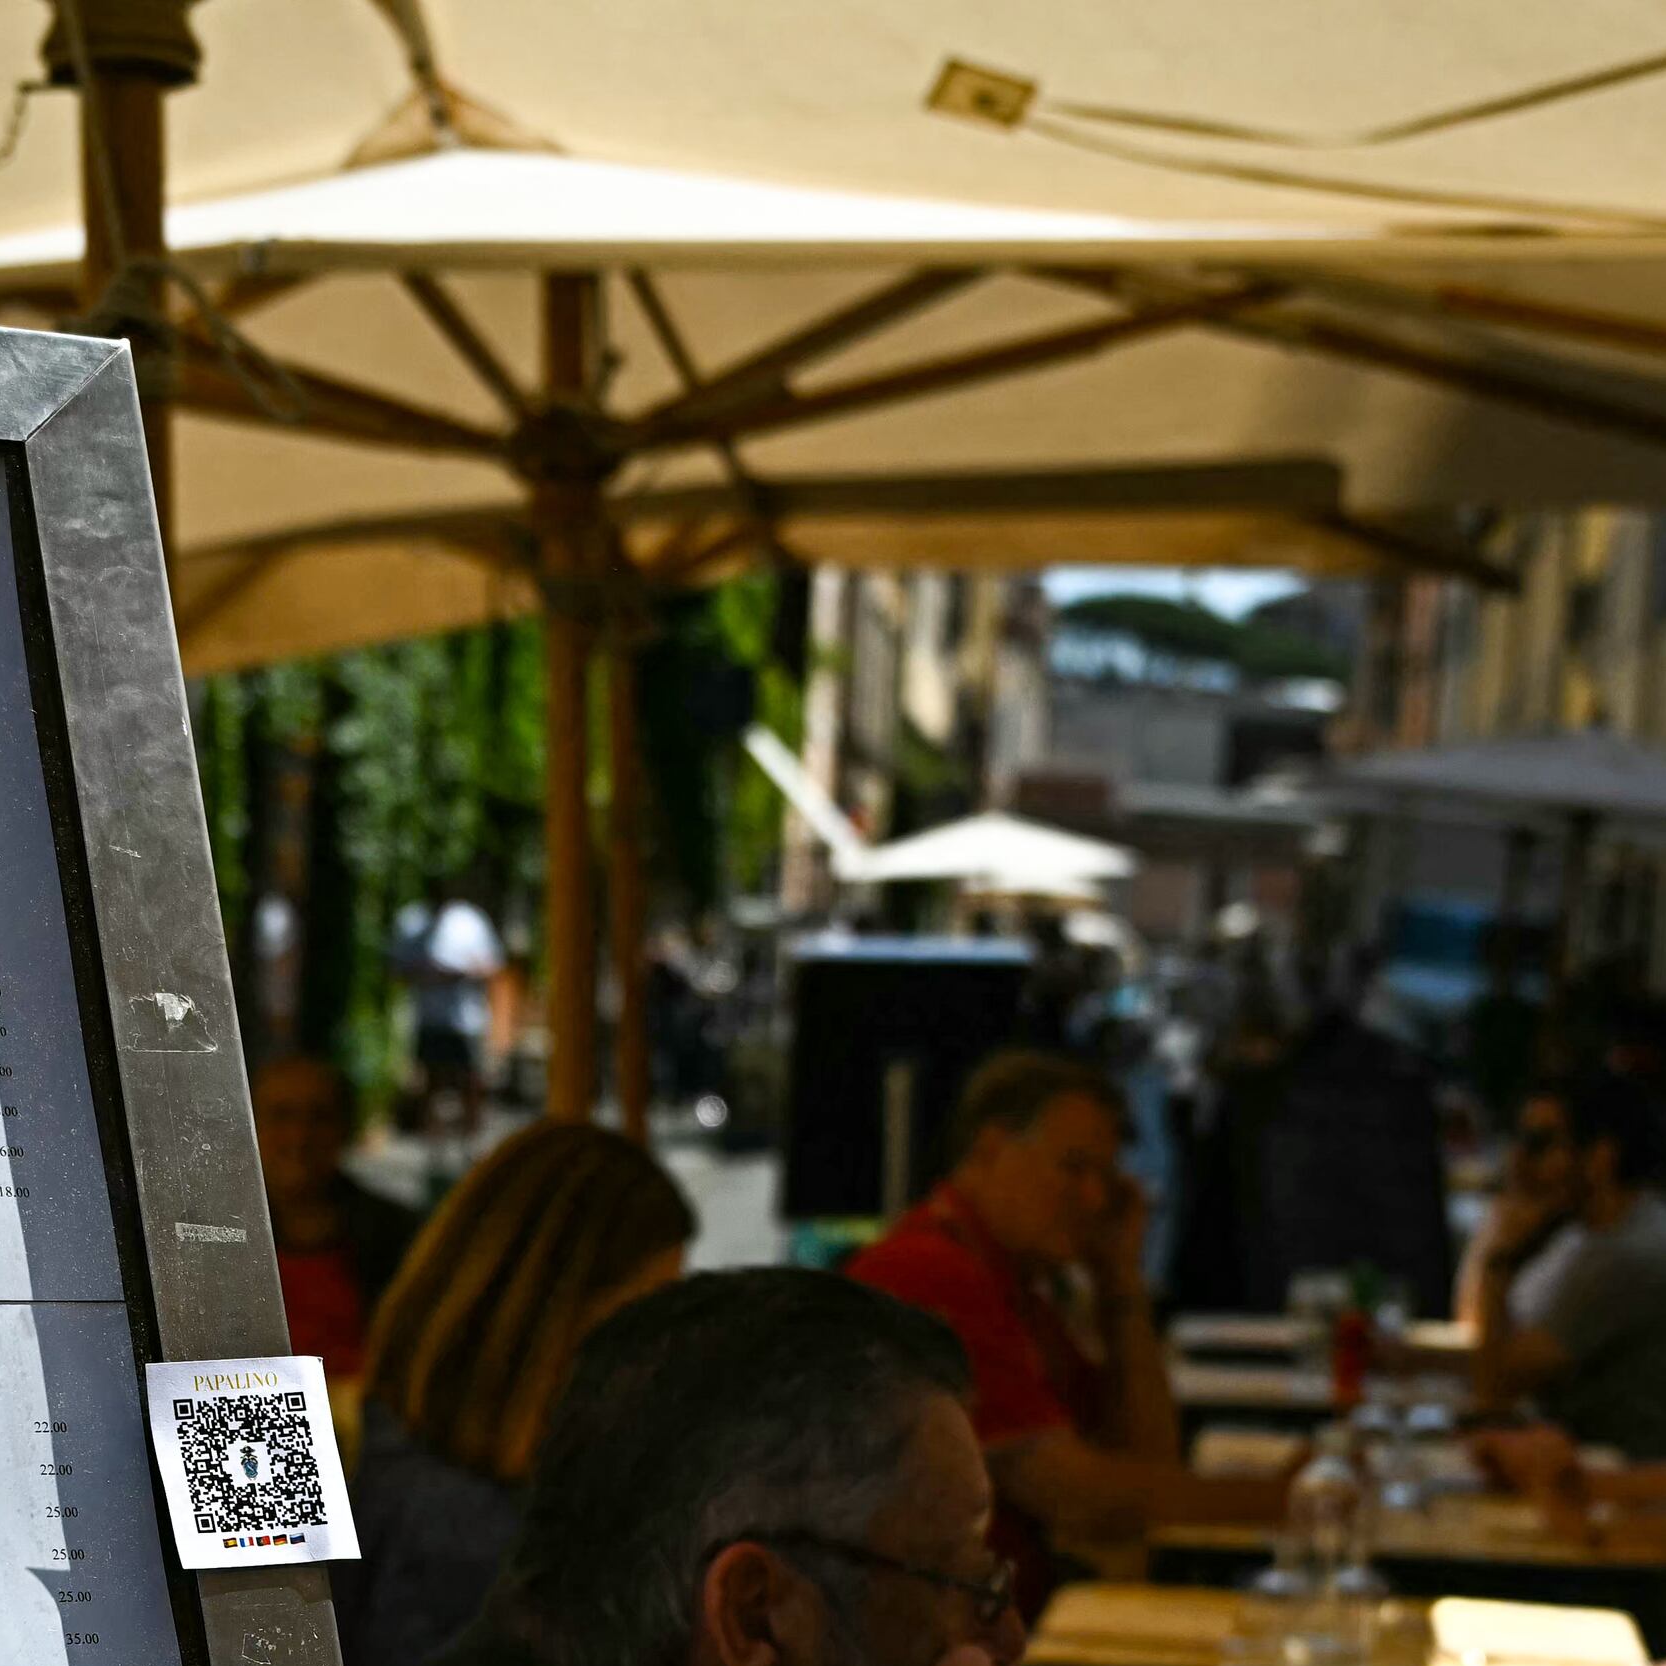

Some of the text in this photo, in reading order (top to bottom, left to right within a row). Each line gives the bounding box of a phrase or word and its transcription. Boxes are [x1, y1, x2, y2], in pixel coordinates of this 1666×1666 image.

[193, 1371, 279, 1392] PAPALINO
[34, 1422, 67, 1433] 22.00
[46, 1507, 78, 1518] 25.00
